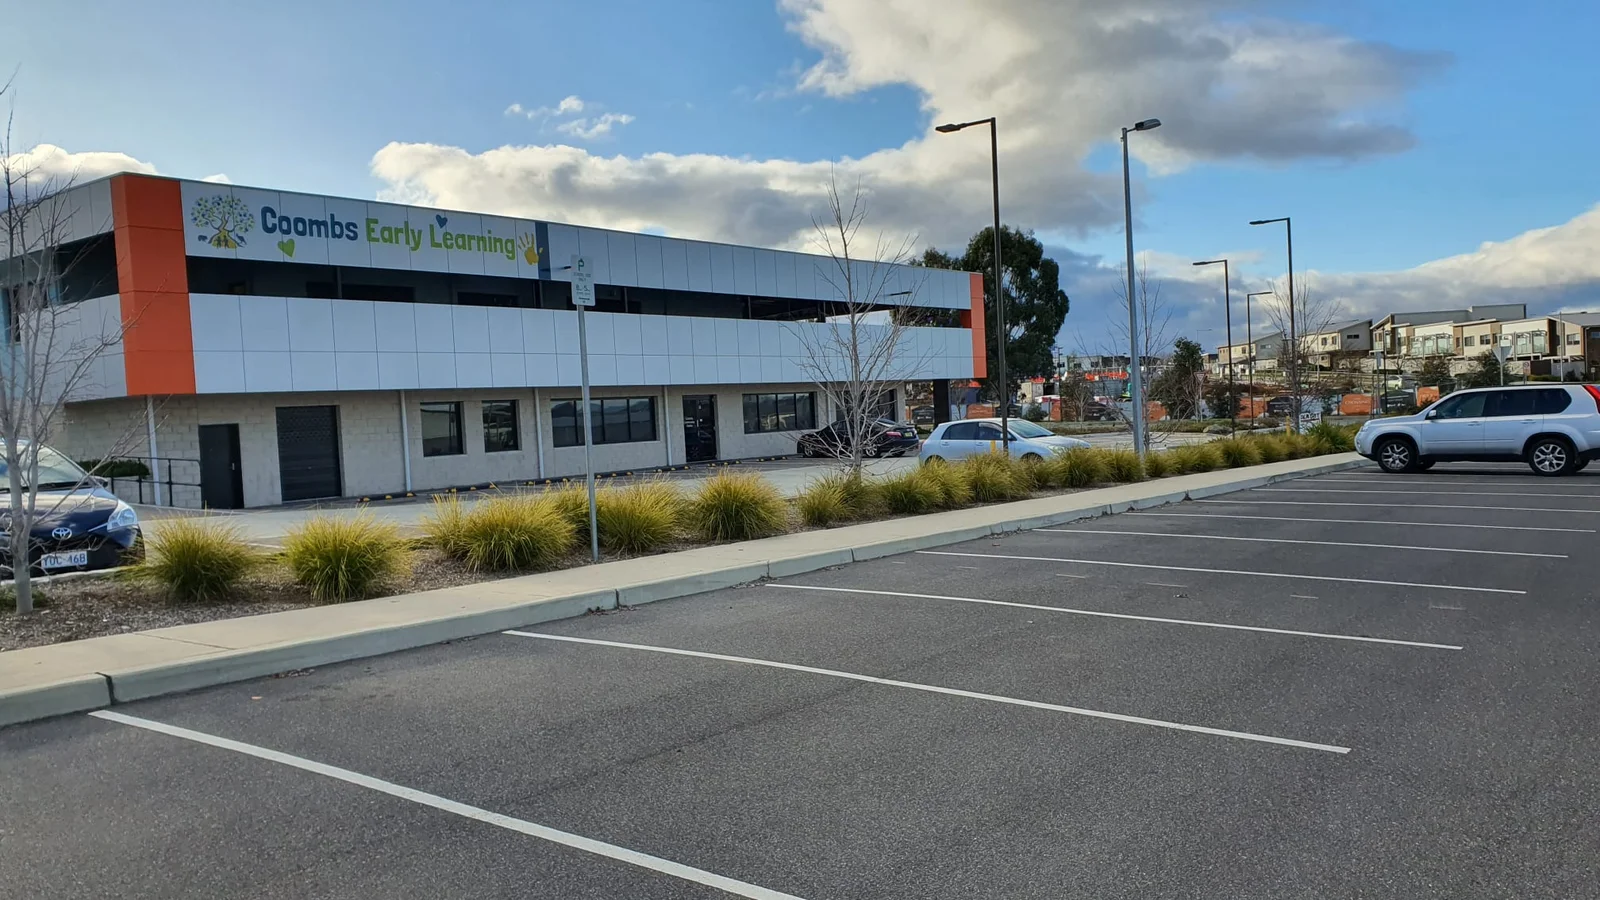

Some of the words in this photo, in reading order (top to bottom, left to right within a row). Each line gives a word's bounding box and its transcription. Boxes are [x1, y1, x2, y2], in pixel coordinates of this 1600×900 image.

[261, 206, 358, 241] Coombs
[365, 218, 422, 251] Early
[429, 223, 516, 260] Learning
